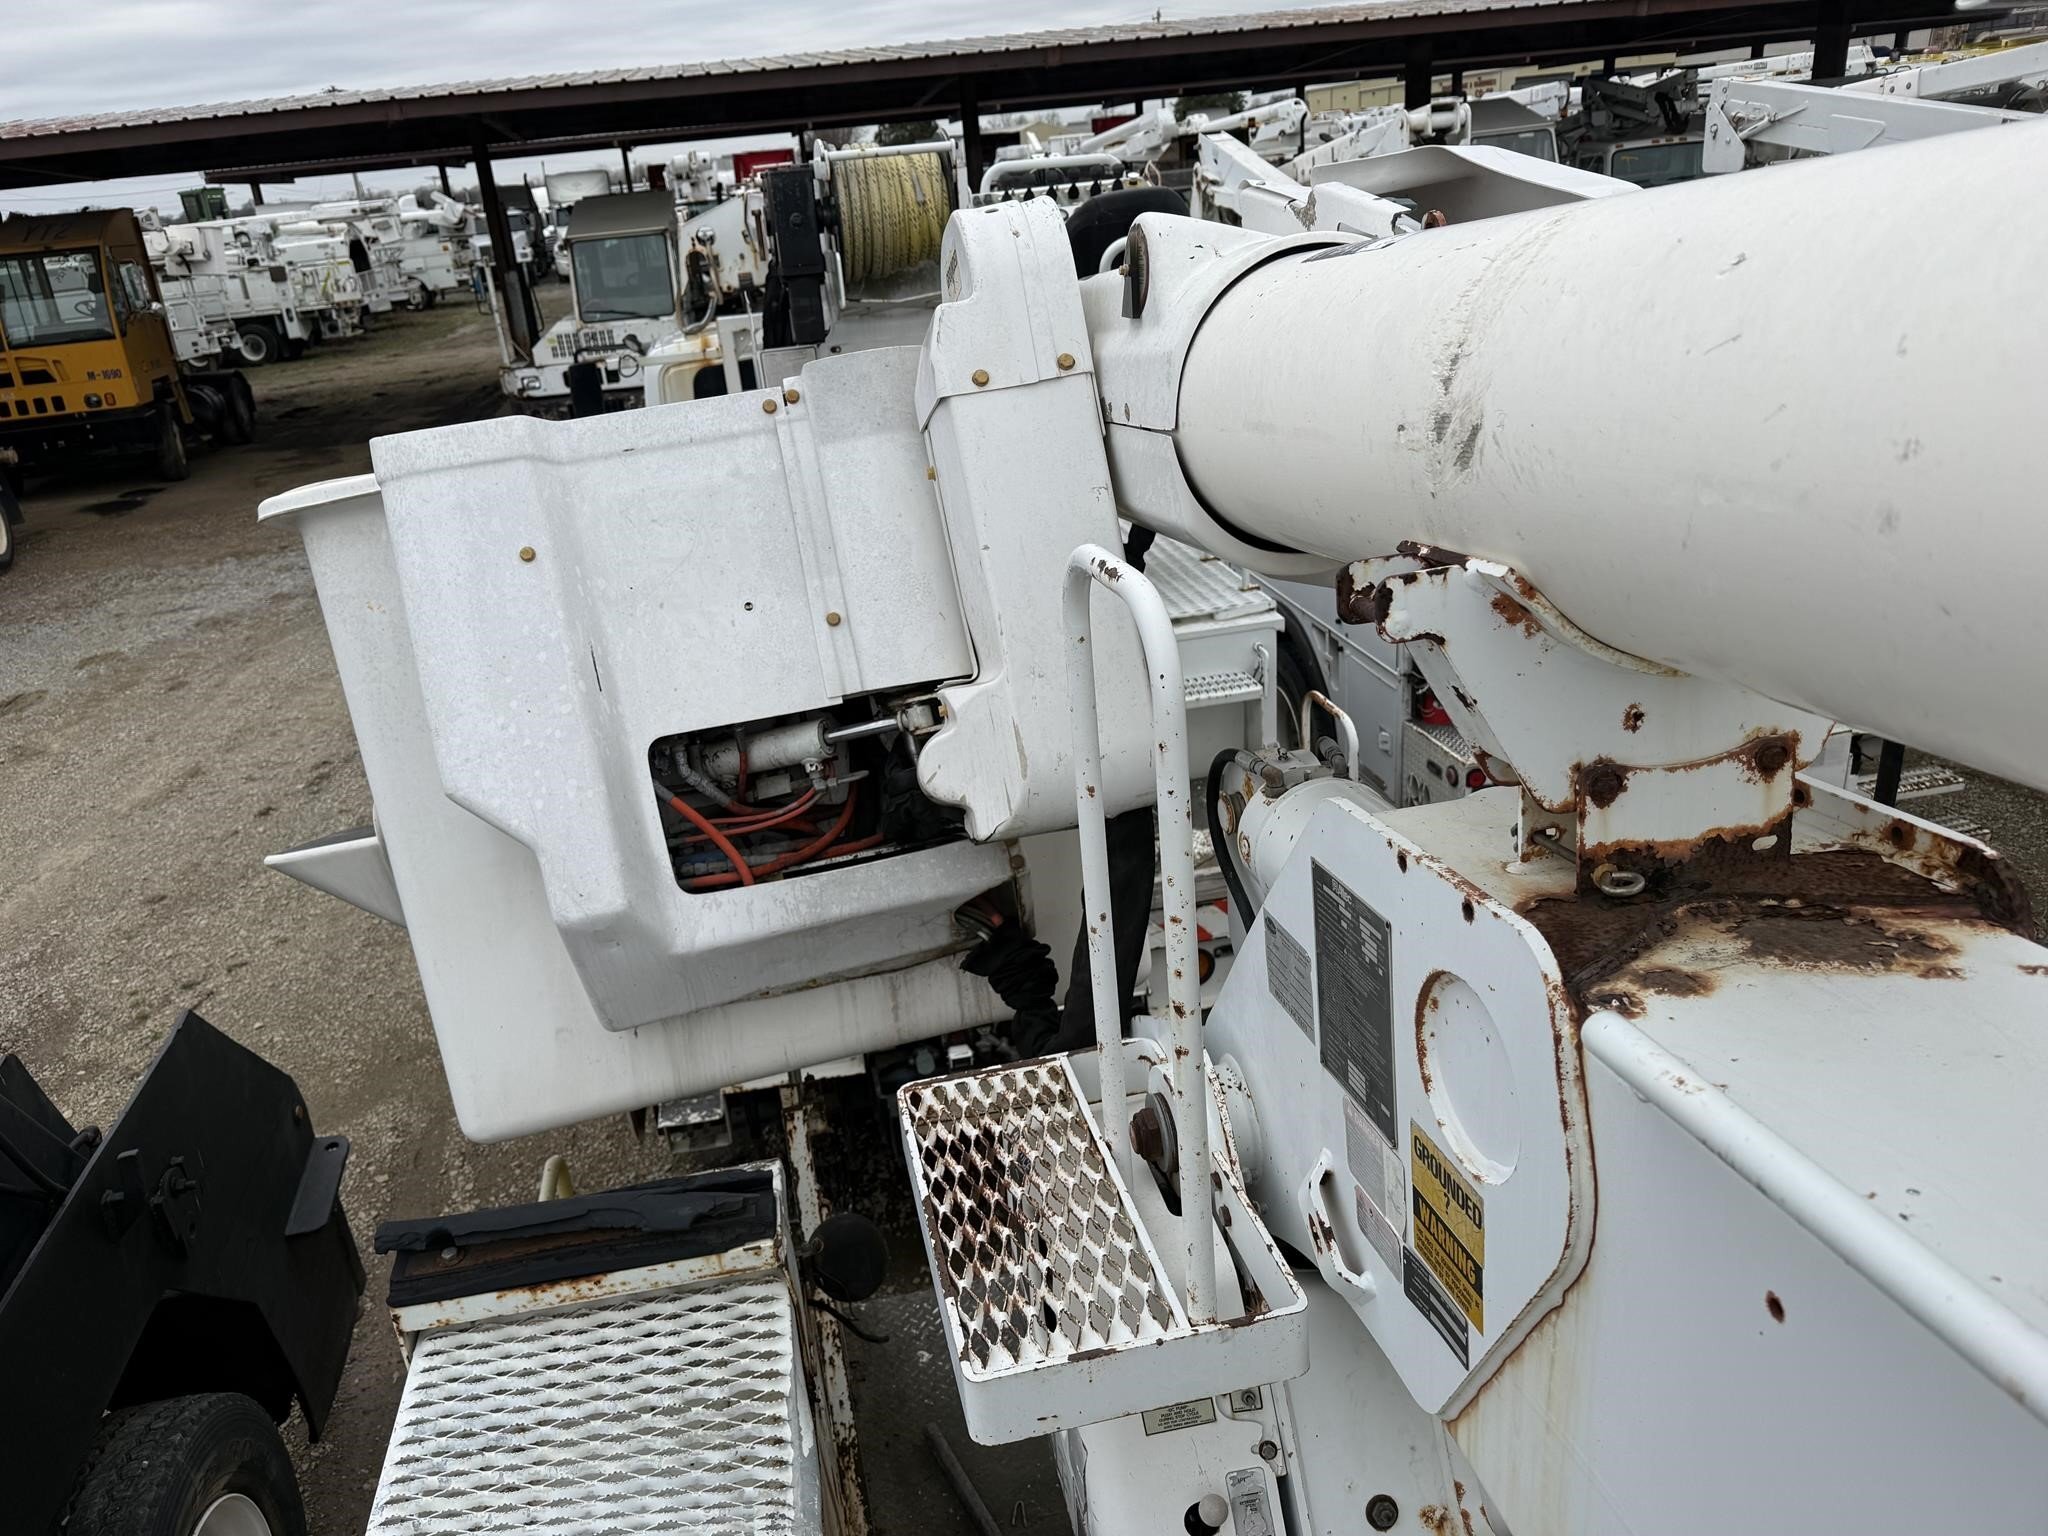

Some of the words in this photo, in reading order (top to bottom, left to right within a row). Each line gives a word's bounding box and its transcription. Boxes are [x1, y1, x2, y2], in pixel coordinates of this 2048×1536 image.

[87, 368, 122, 381] M-1690
[1414, 1135, 1481, 1230] GROUNDED
[1444, 1192, 1450, 1215] ?
[1419, 1199, 1476, 1285] WARNING
